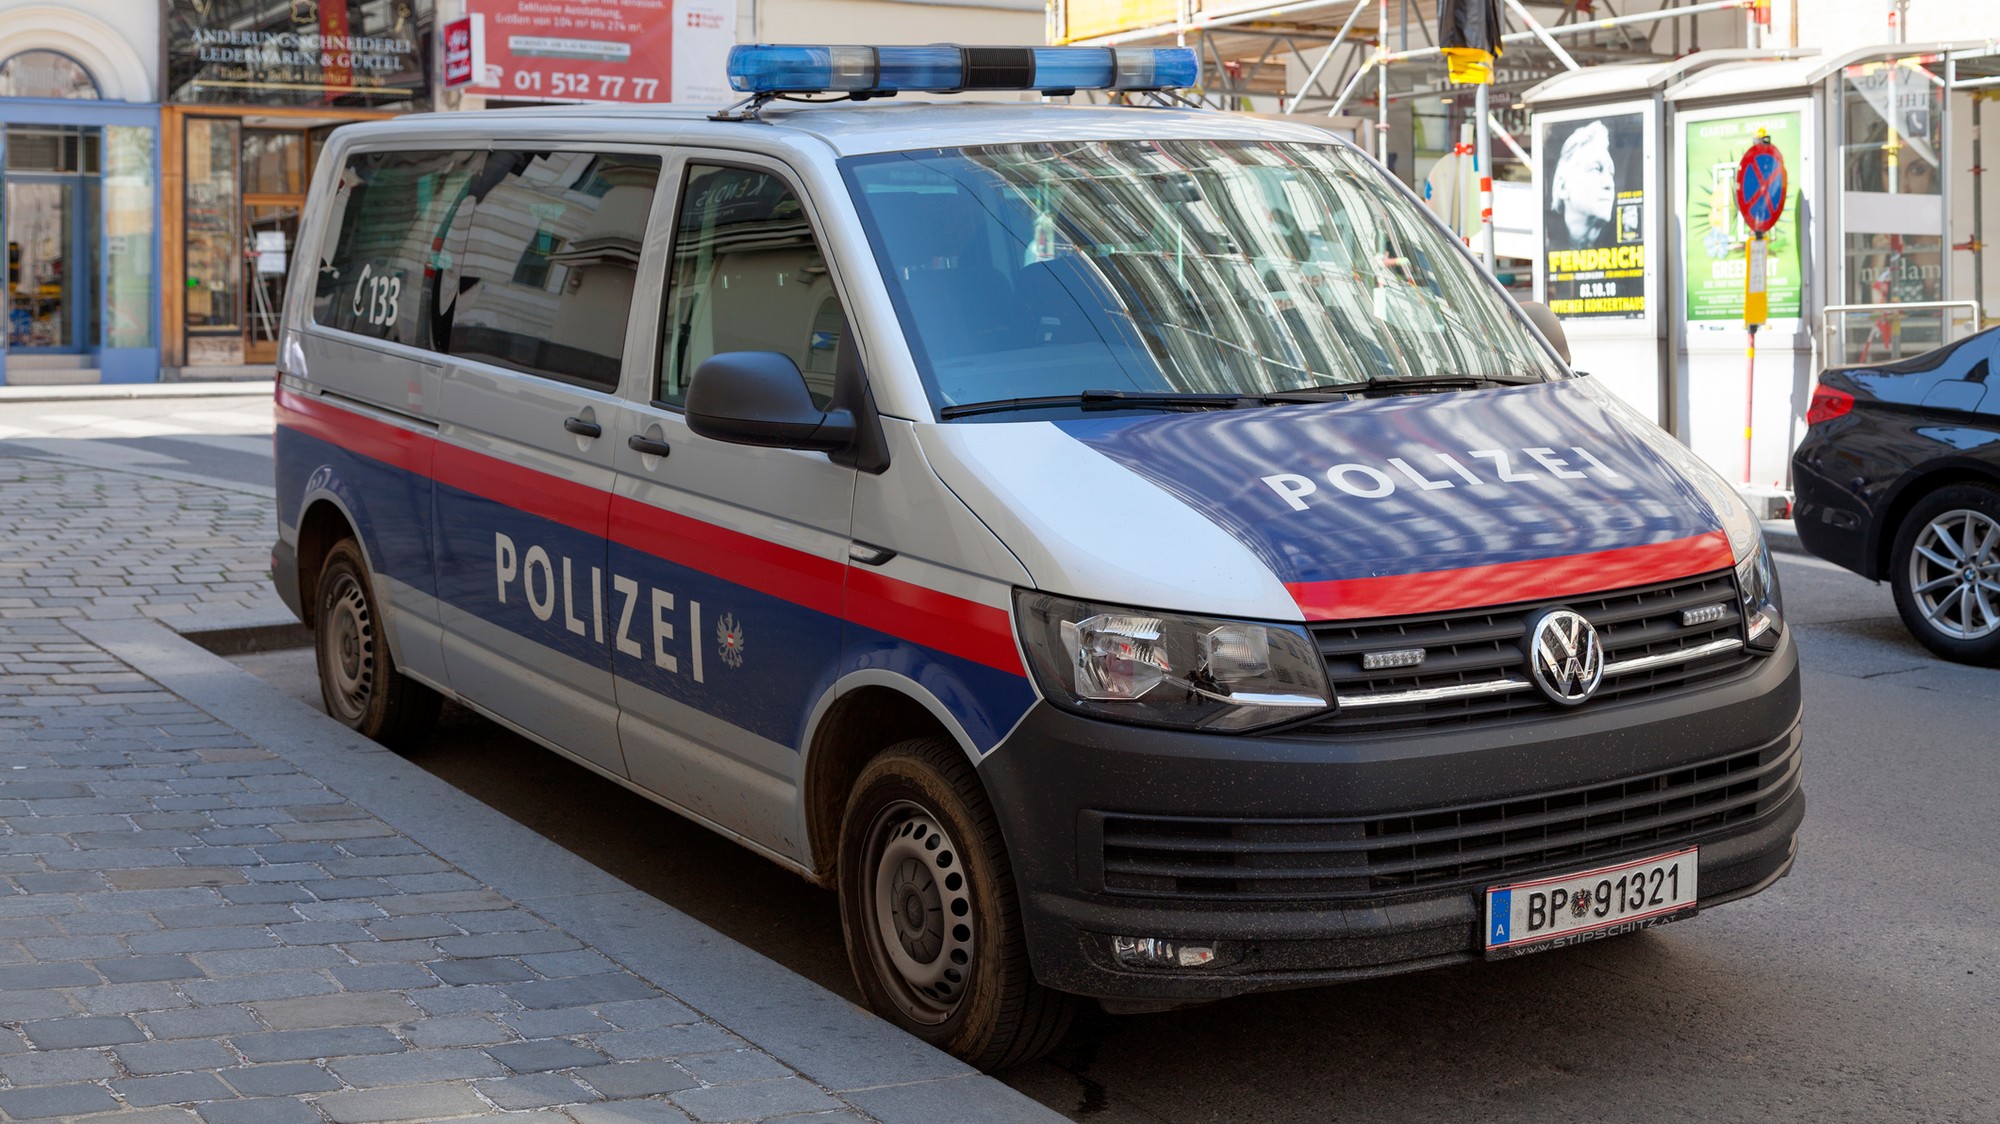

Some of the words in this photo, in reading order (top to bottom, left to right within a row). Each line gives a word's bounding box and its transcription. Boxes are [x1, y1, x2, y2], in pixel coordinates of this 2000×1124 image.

[200, 47, 316, 66] LEDERWAREN
[319, 52, 334, 67] &
[514, 70, 541, 91] 01
[551, 73, 589, 95] 512
[598, 75, 624, 98] 77
[632, 77, 659, 100] 77
[1548, 245, 1644, 273] FENDRICH
[369, 275, 400, 327] 133
[1549, 299, 1584, 314] WIENER
[1585, 296, 1645, 313] KONZERTHAUS
[1261, 446, 1618, 512] POLIZEI
[495, 531, 704, 684] POLIZEI
[1530, 609, 1605, 705] VW
[1495, 924, 1505, 936] A
[1528, 887, 1568, 932] BP
[1594, 862, 1679, 918] 91321
